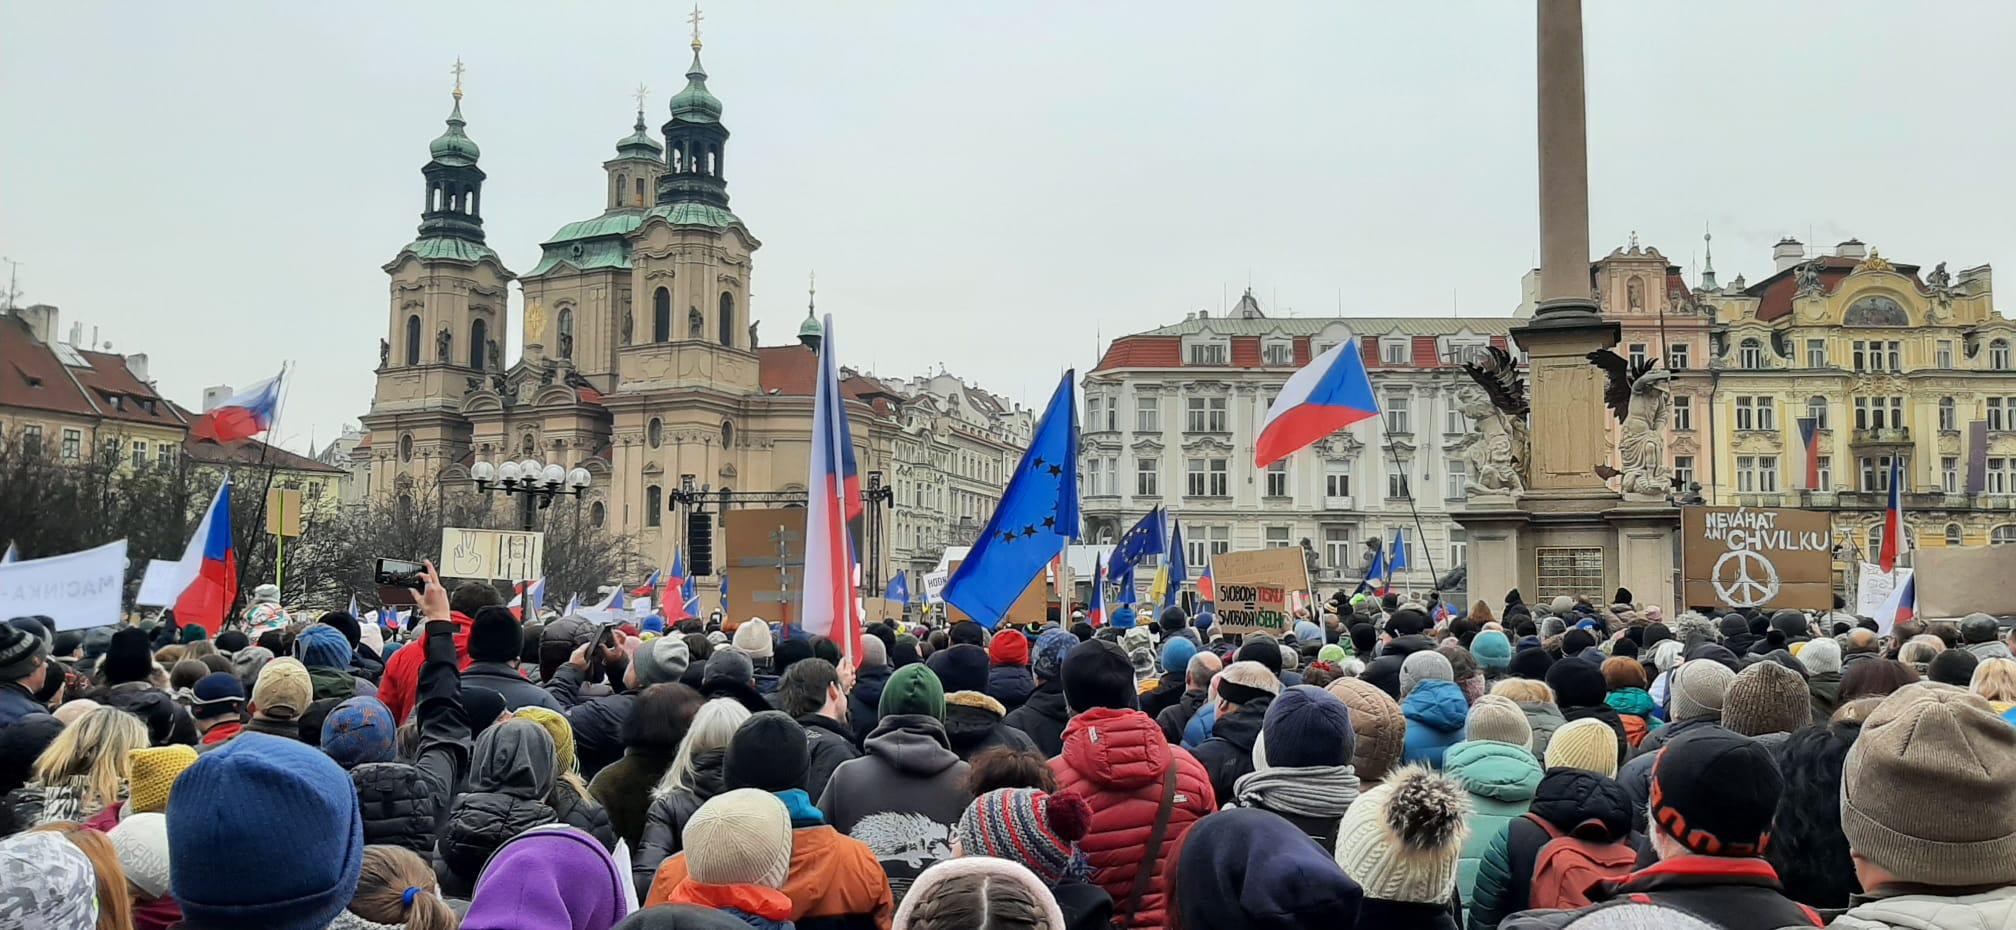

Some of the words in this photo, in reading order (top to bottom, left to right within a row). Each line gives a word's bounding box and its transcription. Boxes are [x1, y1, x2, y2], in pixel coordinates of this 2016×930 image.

[1705, 507, 1777, 529] NEVÁHAT
[1704, 528, 1727, 540] ANI
[1727, 529, 1829, 551] CHVILKU
[1220, 585, 1256, 602] SVOBODA
[1257, 586, 1284, 603] TISKU
[1218, 609, 1255, 627] SVOBODA
